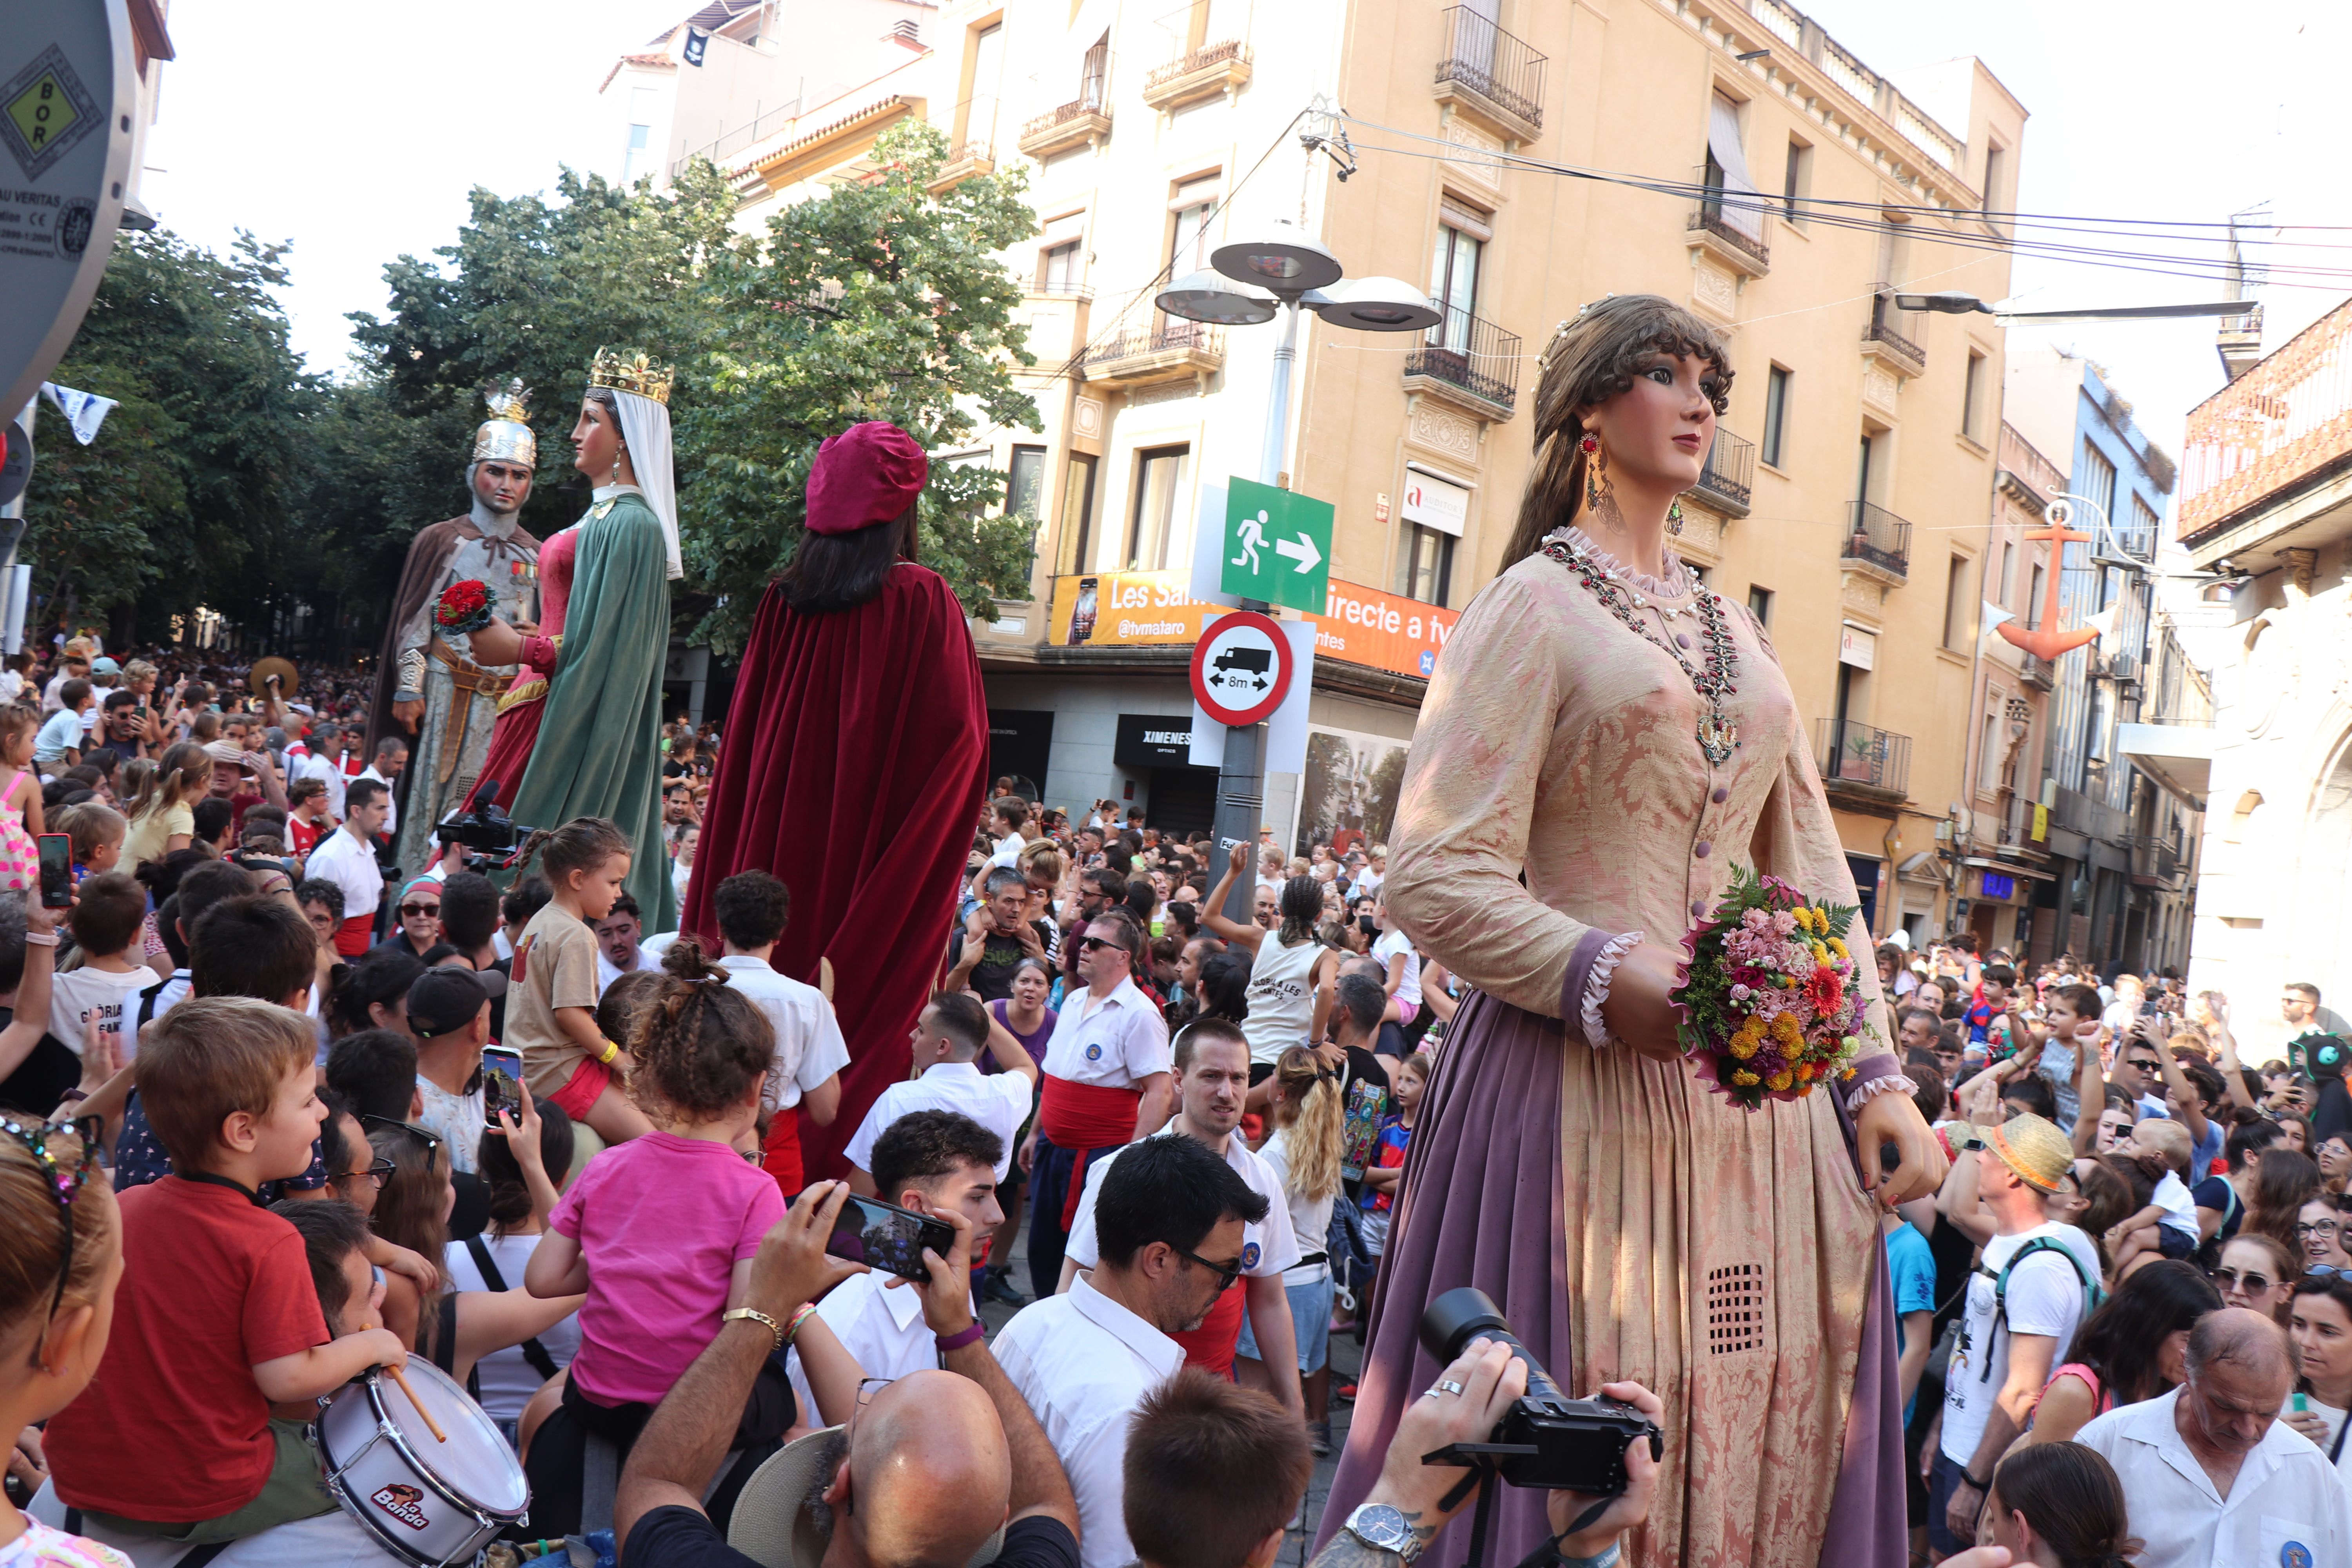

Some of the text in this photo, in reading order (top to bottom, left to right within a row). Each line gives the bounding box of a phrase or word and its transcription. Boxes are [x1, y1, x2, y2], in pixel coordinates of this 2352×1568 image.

[15, 189, 61, 208] VERITAS
[1111, 579, 1149, 609] Les
[1325, 584, 1401, 634] irecte
[1407, 616, 1422, 639] a
[1118, 619, 1185, 638] @tvmataro
[1315, 631, 1345, 651] ntes
[1229, 676, 1247, 688] 8m
[1142, 731, 1192, 745] XIMENES
[1277, 980, 1283, 989] A
[1284, 984, 1301, 996] LES
[373, 1489, 427, 1527] Banda
[401, 1501, 419, 1514] La
